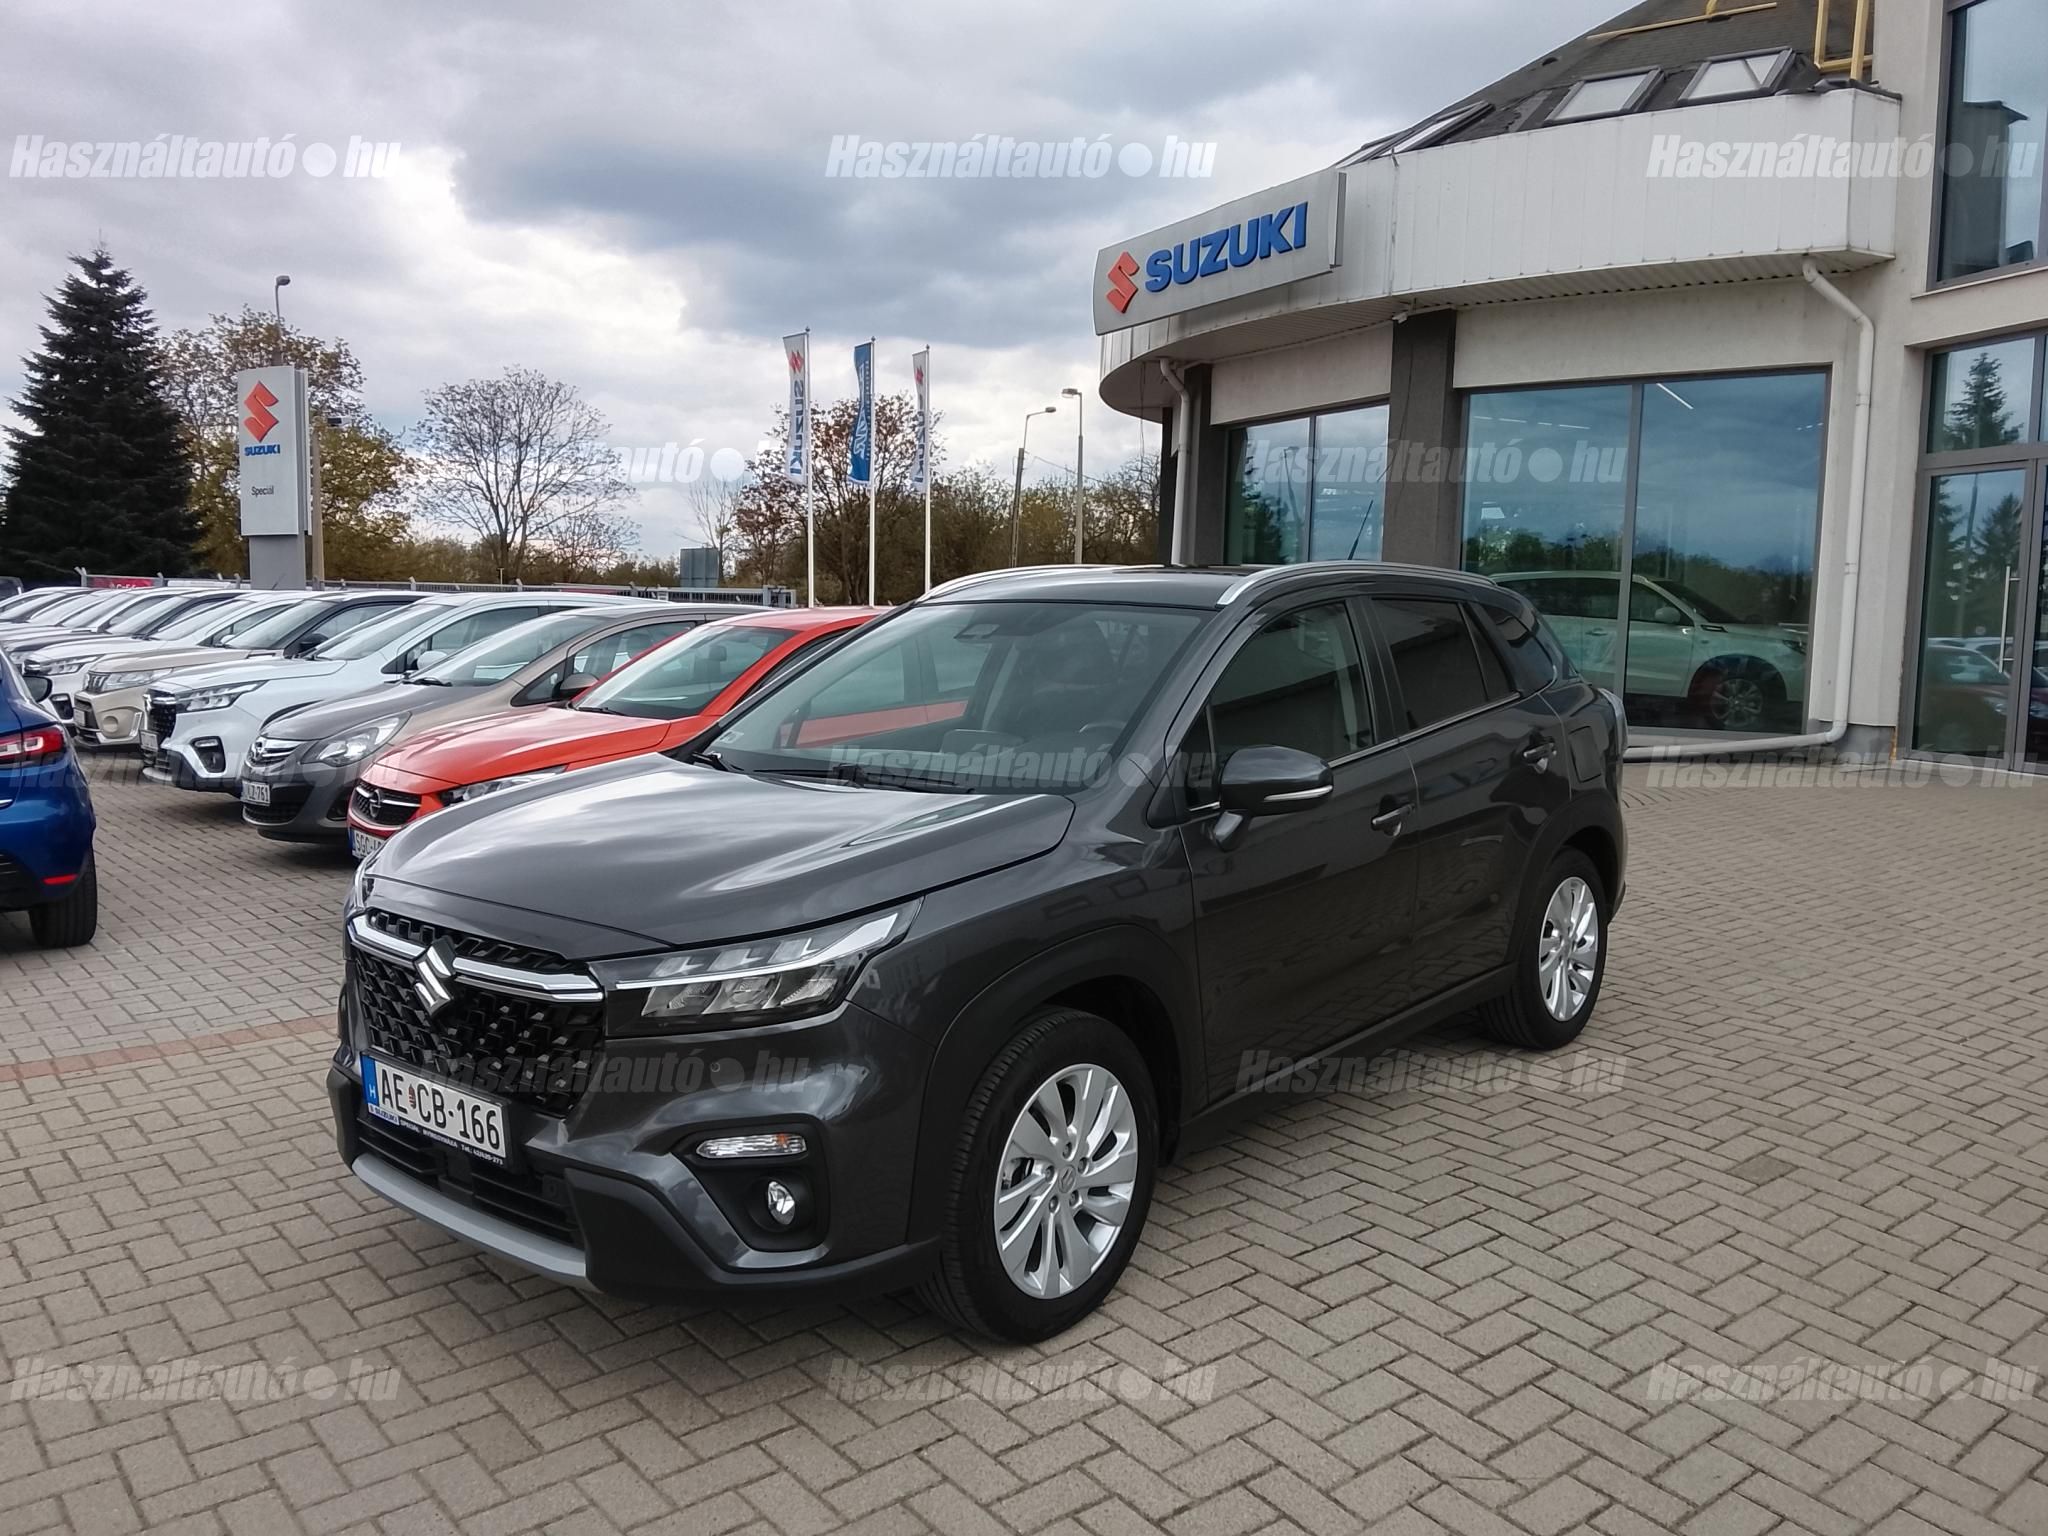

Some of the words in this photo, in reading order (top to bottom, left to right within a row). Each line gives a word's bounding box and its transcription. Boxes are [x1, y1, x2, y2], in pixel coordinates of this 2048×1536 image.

[1145, 201, 1309, 293] SUZUKI
[244, 444, 281, 457] SUZUKI
[368, 1083, 377, 1099] H
